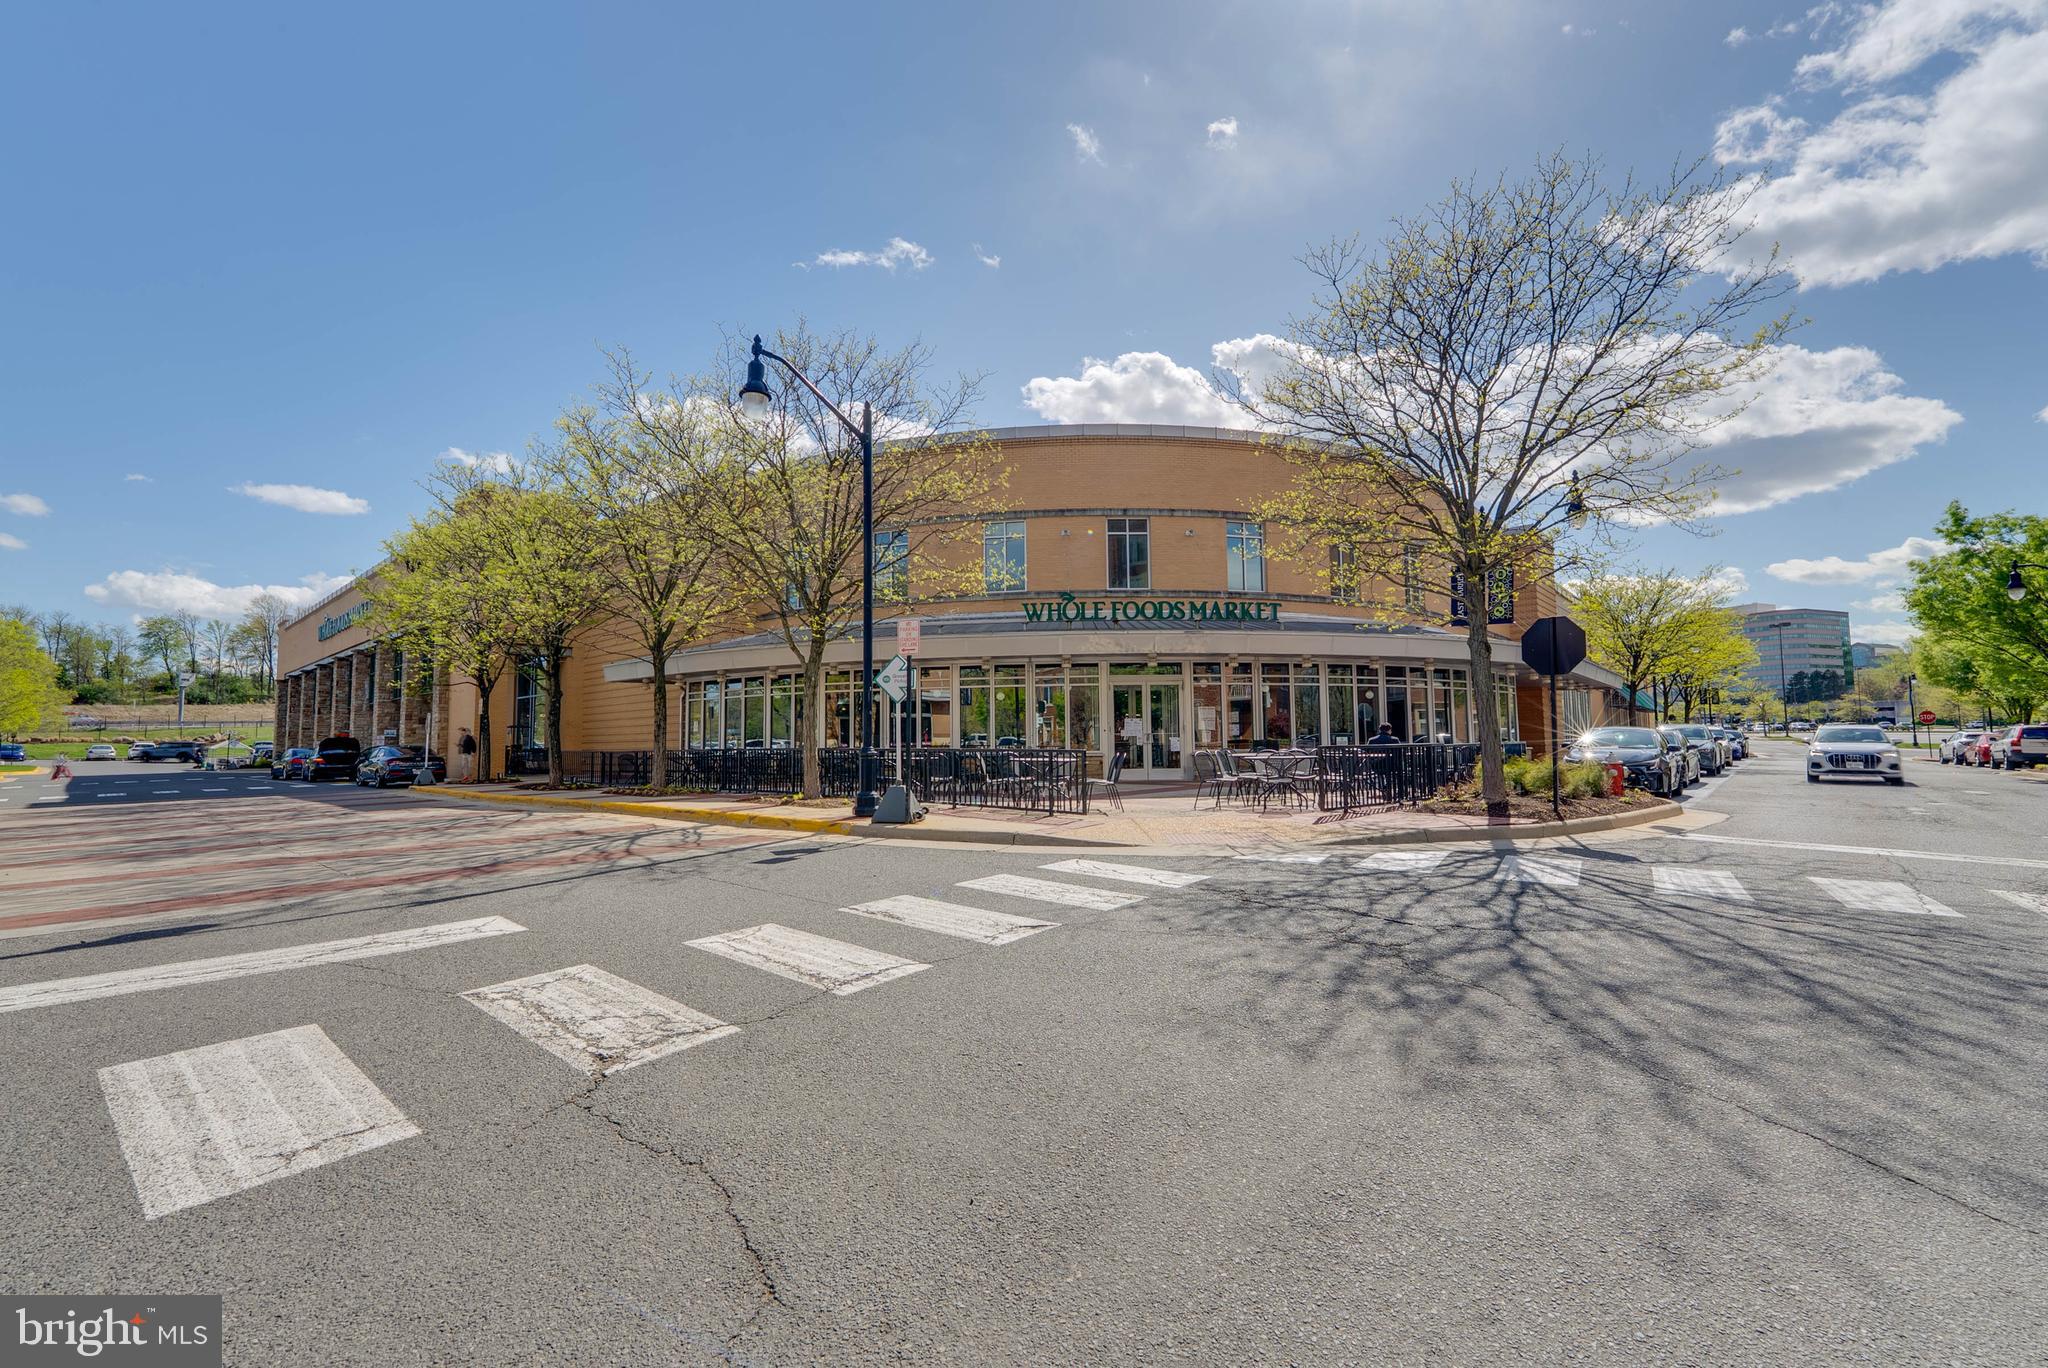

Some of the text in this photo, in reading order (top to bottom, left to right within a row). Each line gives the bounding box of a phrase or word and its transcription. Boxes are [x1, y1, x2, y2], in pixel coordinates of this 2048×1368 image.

[1022, 600, 1282, 622] WHOLE FOODS MARKET
